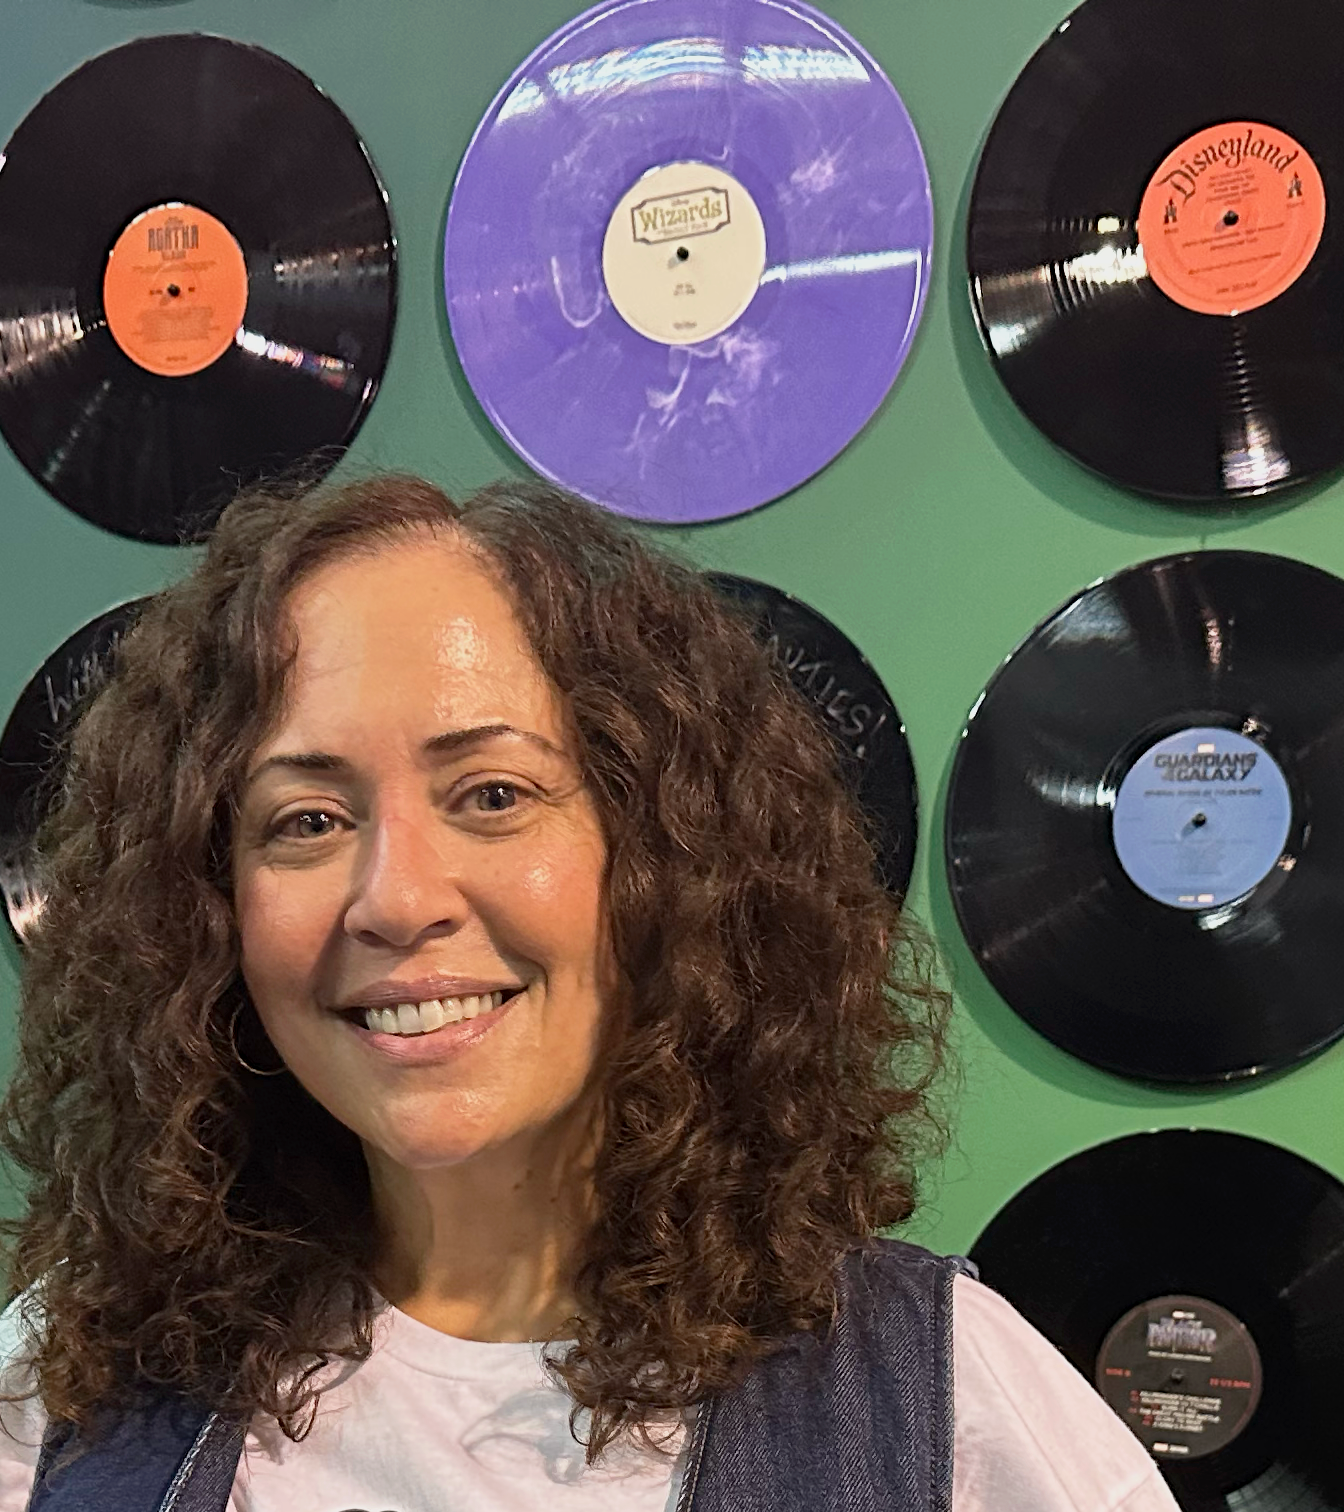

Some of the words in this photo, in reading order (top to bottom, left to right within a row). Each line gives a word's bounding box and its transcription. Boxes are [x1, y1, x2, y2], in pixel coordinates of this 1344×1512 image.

[1155, 129, 1299, 208] Disneyland
[638, 197, 723, 232] Wizards
[1154, 752, 1259, 769] GUARDIANS
[1177, 767, 1251, 781] GALAXY
